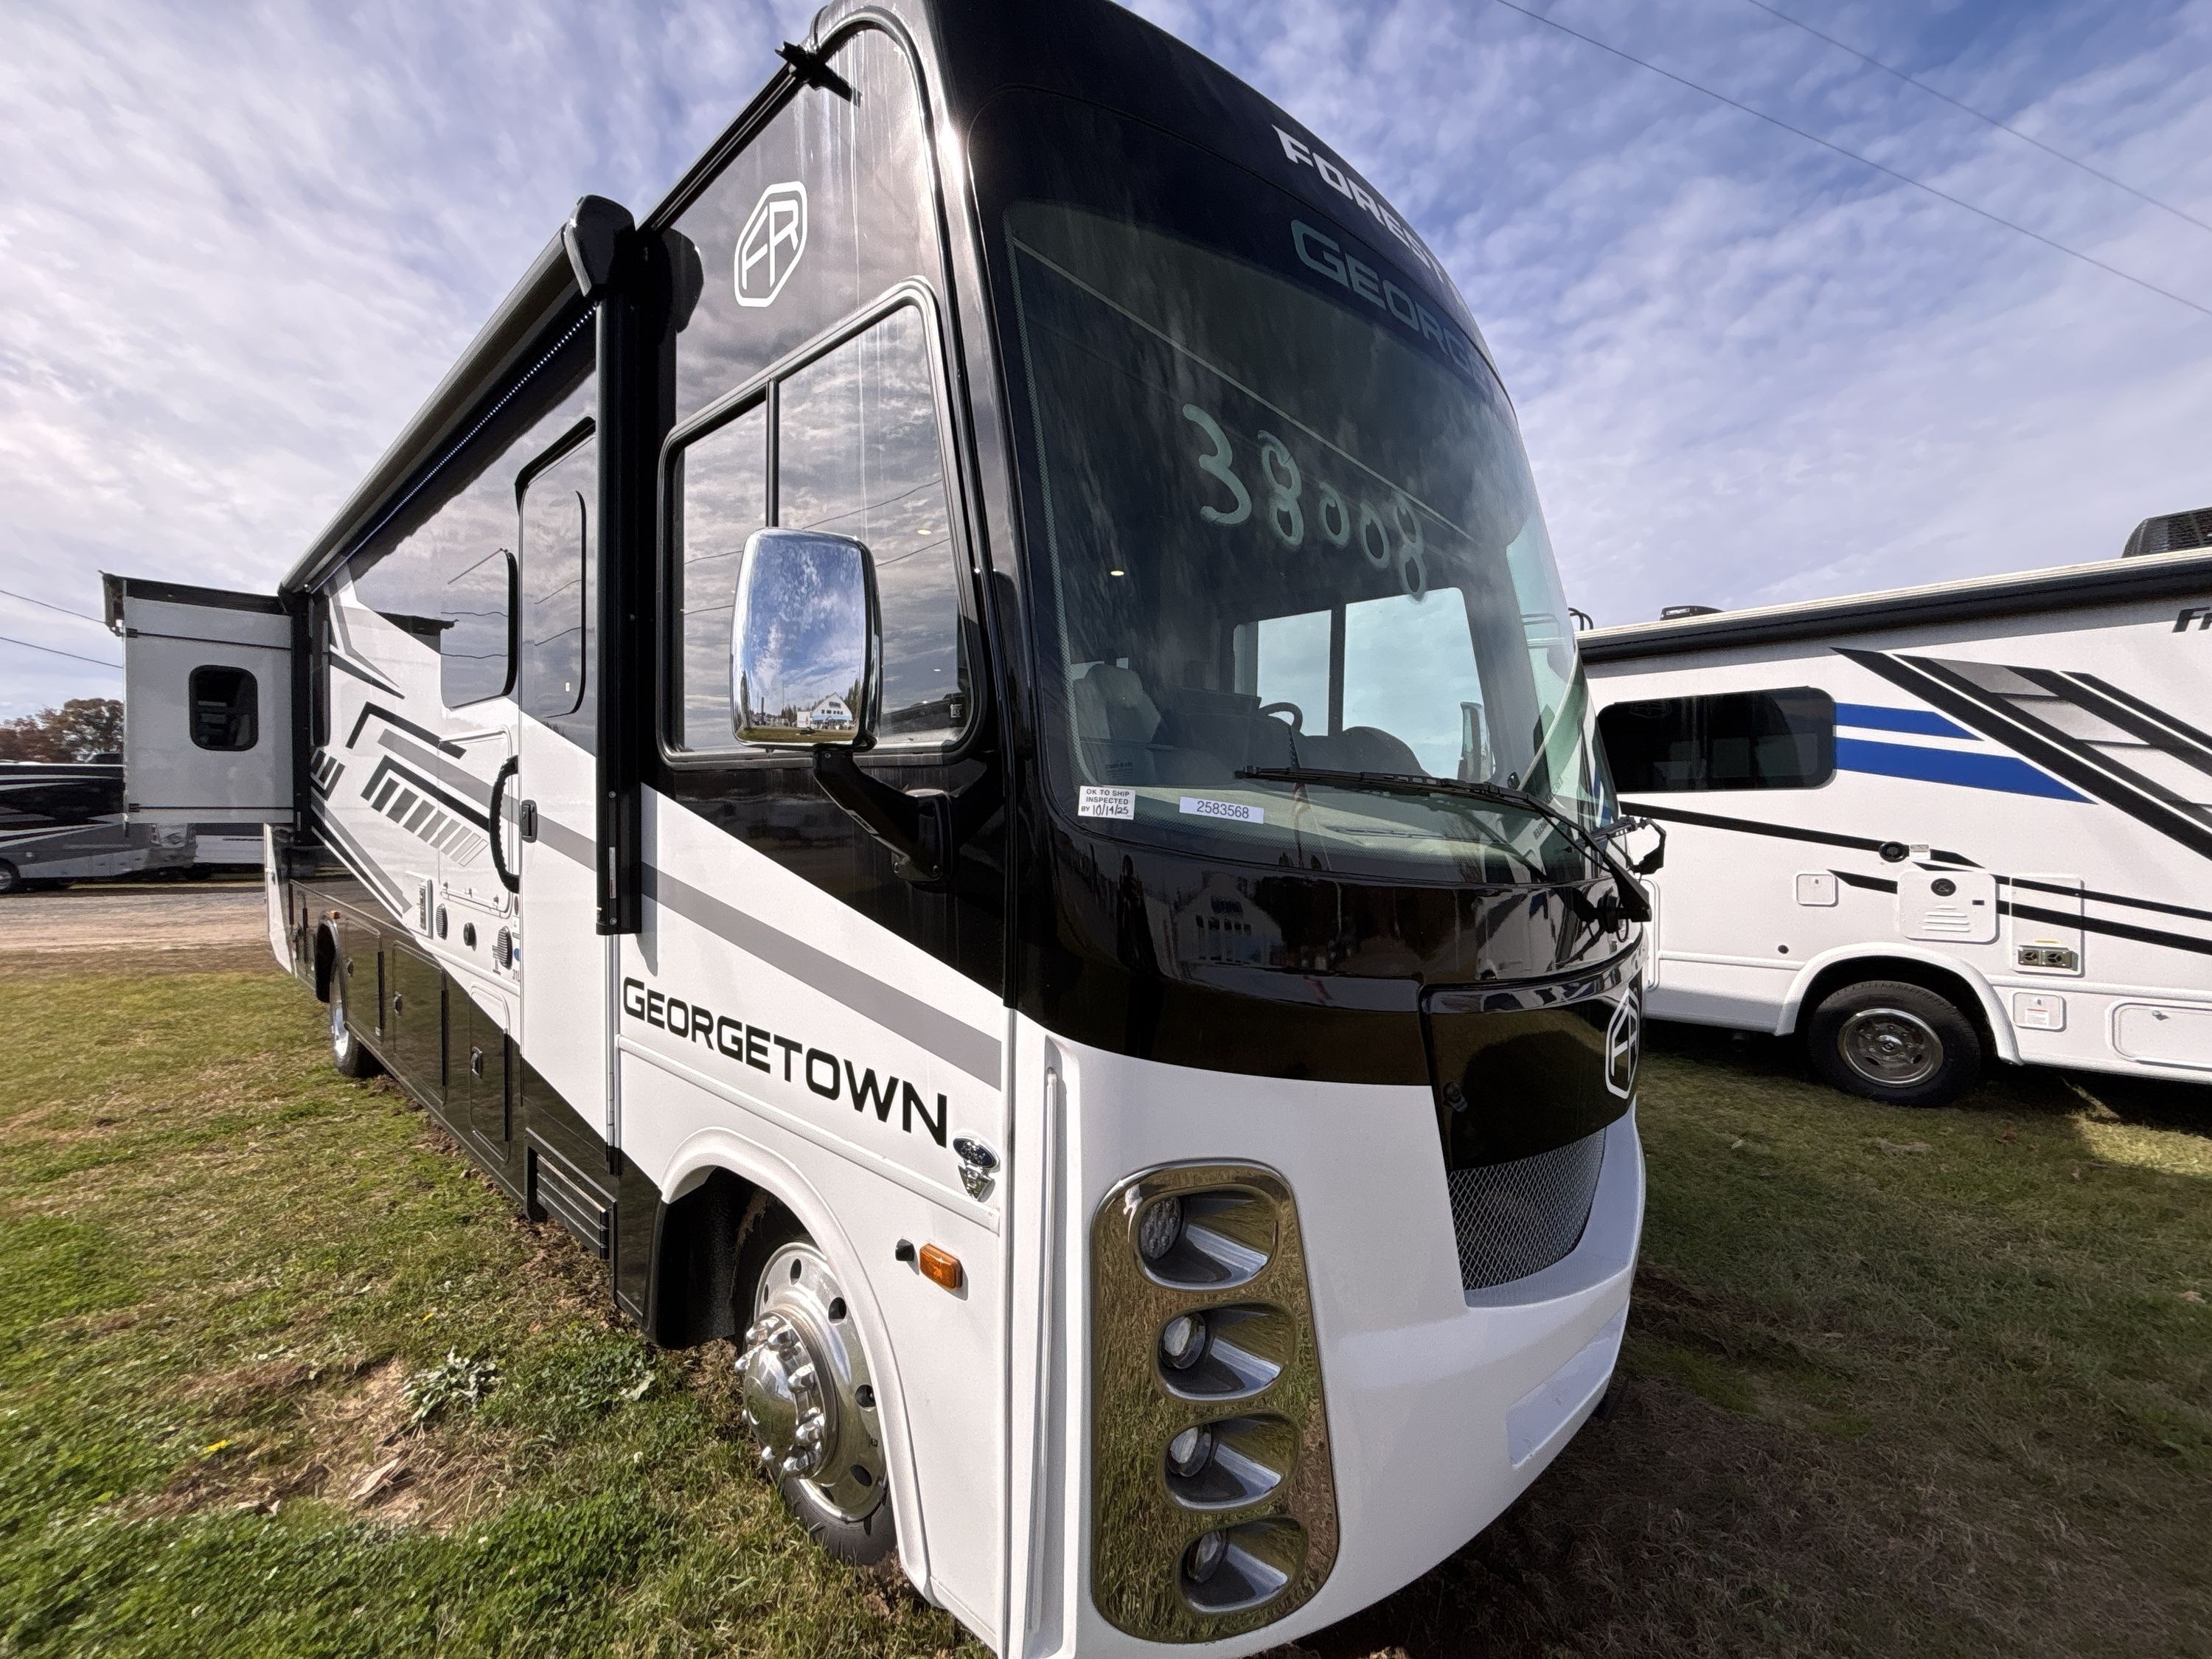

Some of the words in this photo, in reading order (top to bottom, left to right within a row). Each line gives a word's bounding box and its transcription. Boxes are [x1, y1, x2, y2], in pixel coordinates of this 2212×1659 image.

[1183, 404, 1427, 602] 38008
[1086, 796, 1129, 804] INSPECTED
[1093, 804, 1129, 815] 10/14/25
[1197, 801, 1249, 818] 2583568
[623, 976, 947, 1149] GEORGETOWN
